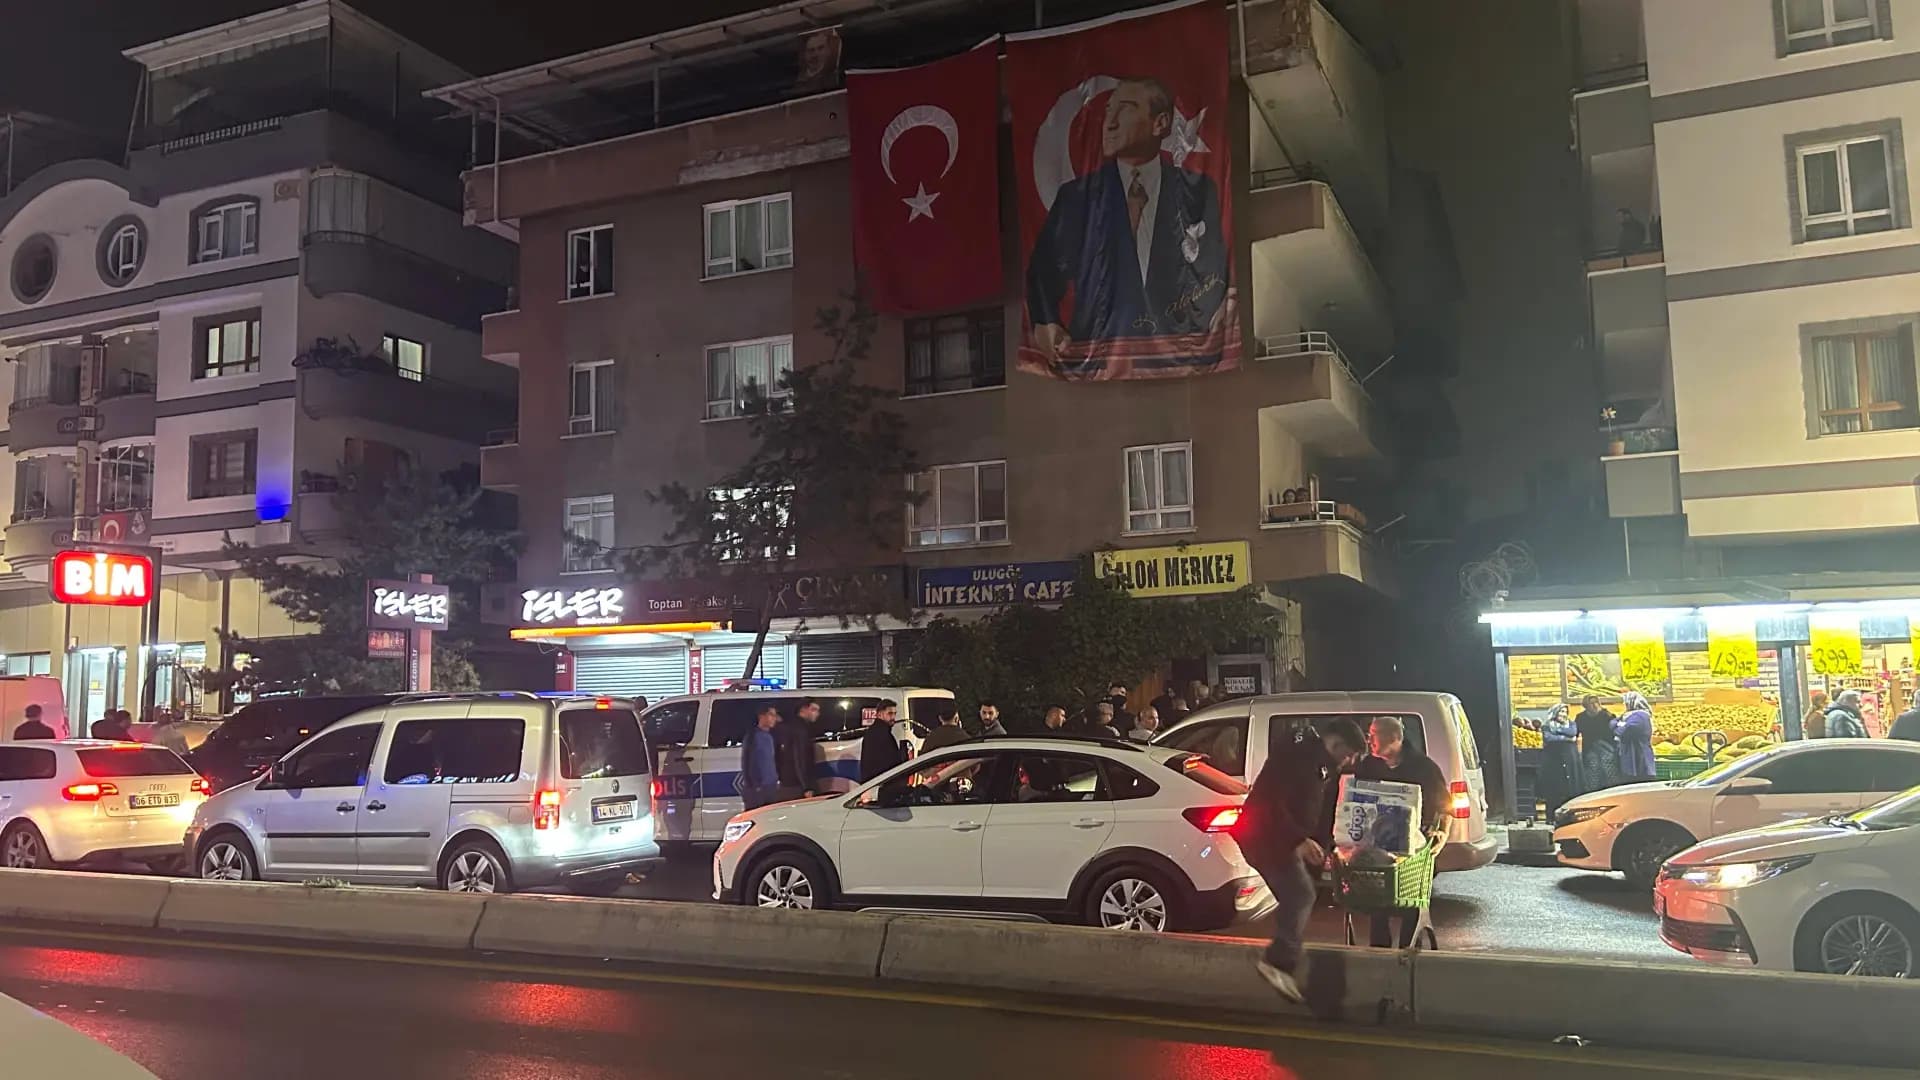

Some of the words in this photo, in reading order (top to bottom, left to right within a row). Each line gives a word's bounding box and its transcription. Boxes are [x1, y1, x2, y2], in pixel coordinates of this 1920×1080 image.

[64, 553, 145, 598] BİM
[1164, 554, 1235, 587] MERKEZ
[1024, 579, 1074, 601] CAFE
[648, 599, 682, 611] Toptan
[865, 710, 877, 719] 112
[1350, 806, 1366, 841] drop
